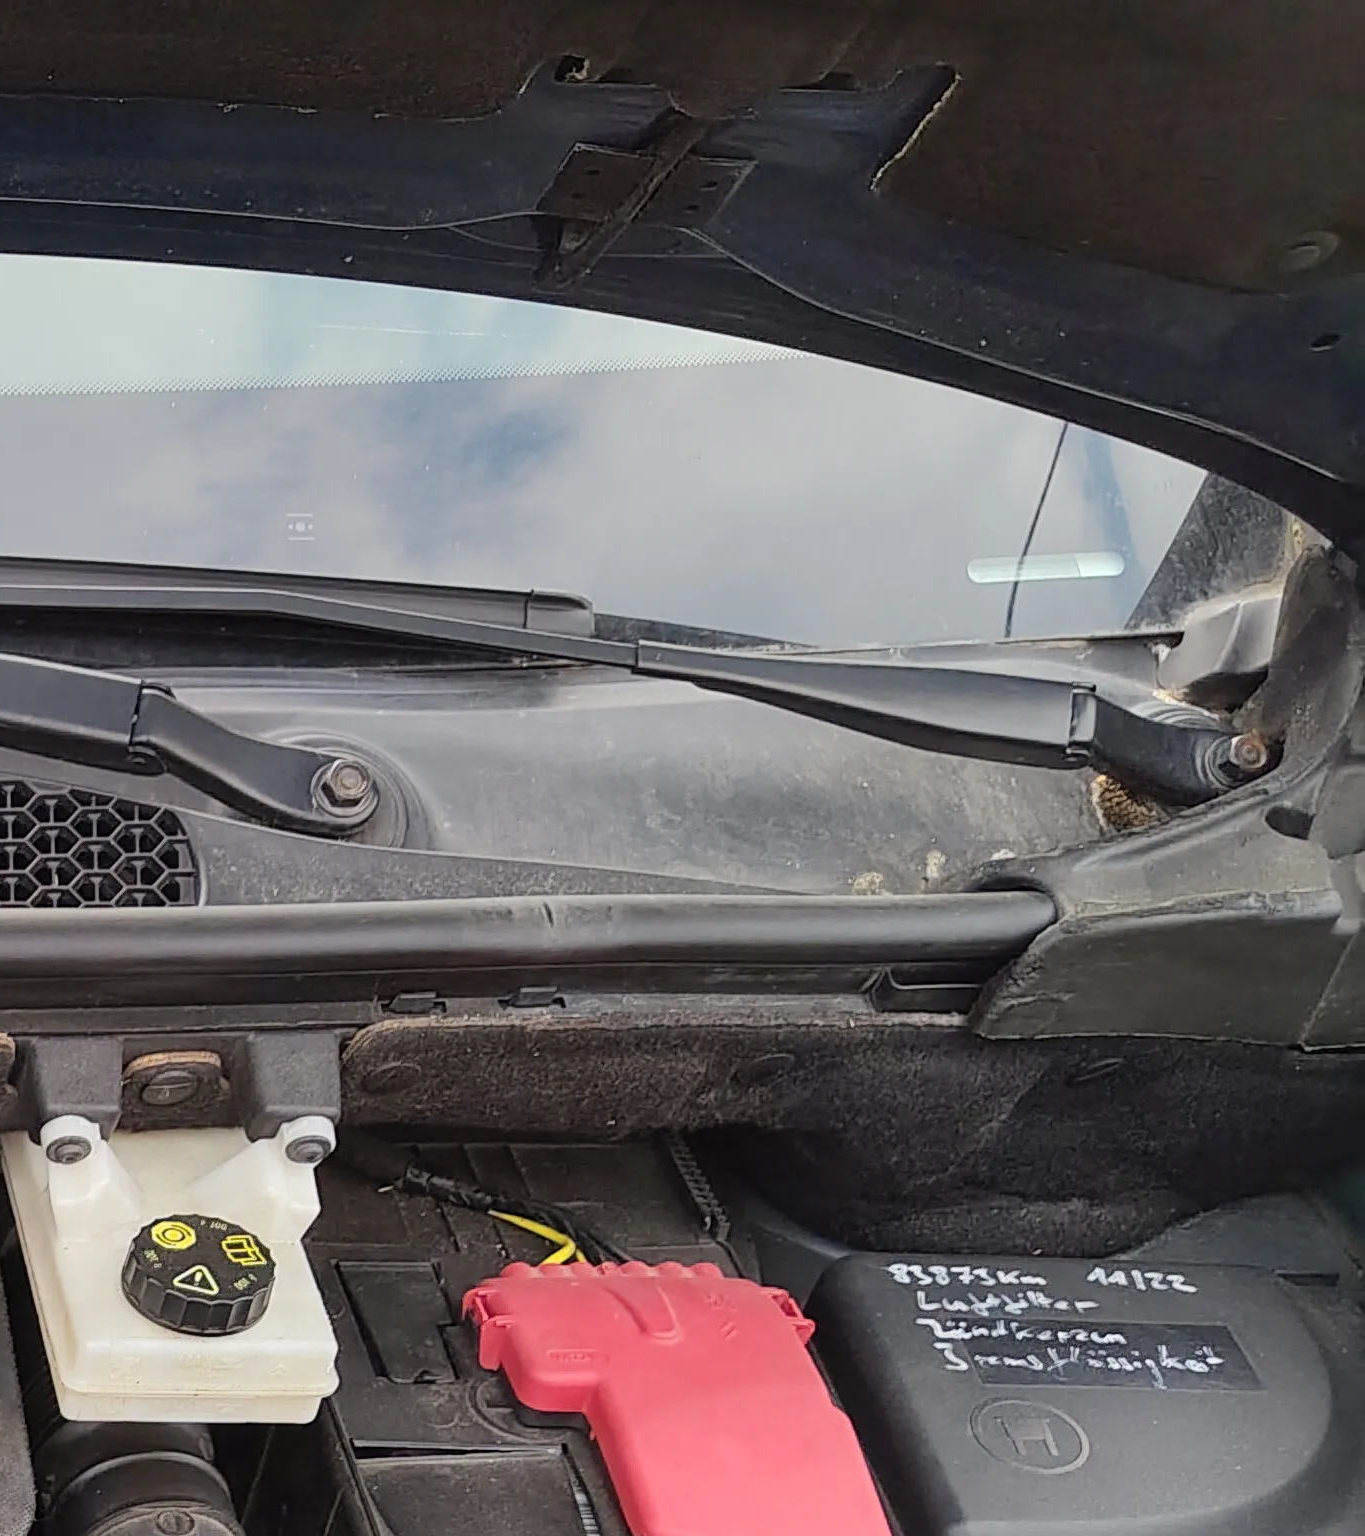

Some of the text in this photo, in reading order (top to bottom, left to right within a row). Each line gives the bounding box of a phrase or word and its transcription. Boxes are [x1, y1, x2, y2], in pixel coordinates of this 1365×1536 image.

[1086, 1266, 1198, 1293] 11/22
[915, 1290, 1100, 1317] Luftfilter
[915, 1317, 1127, 1345] Zündkerzen
